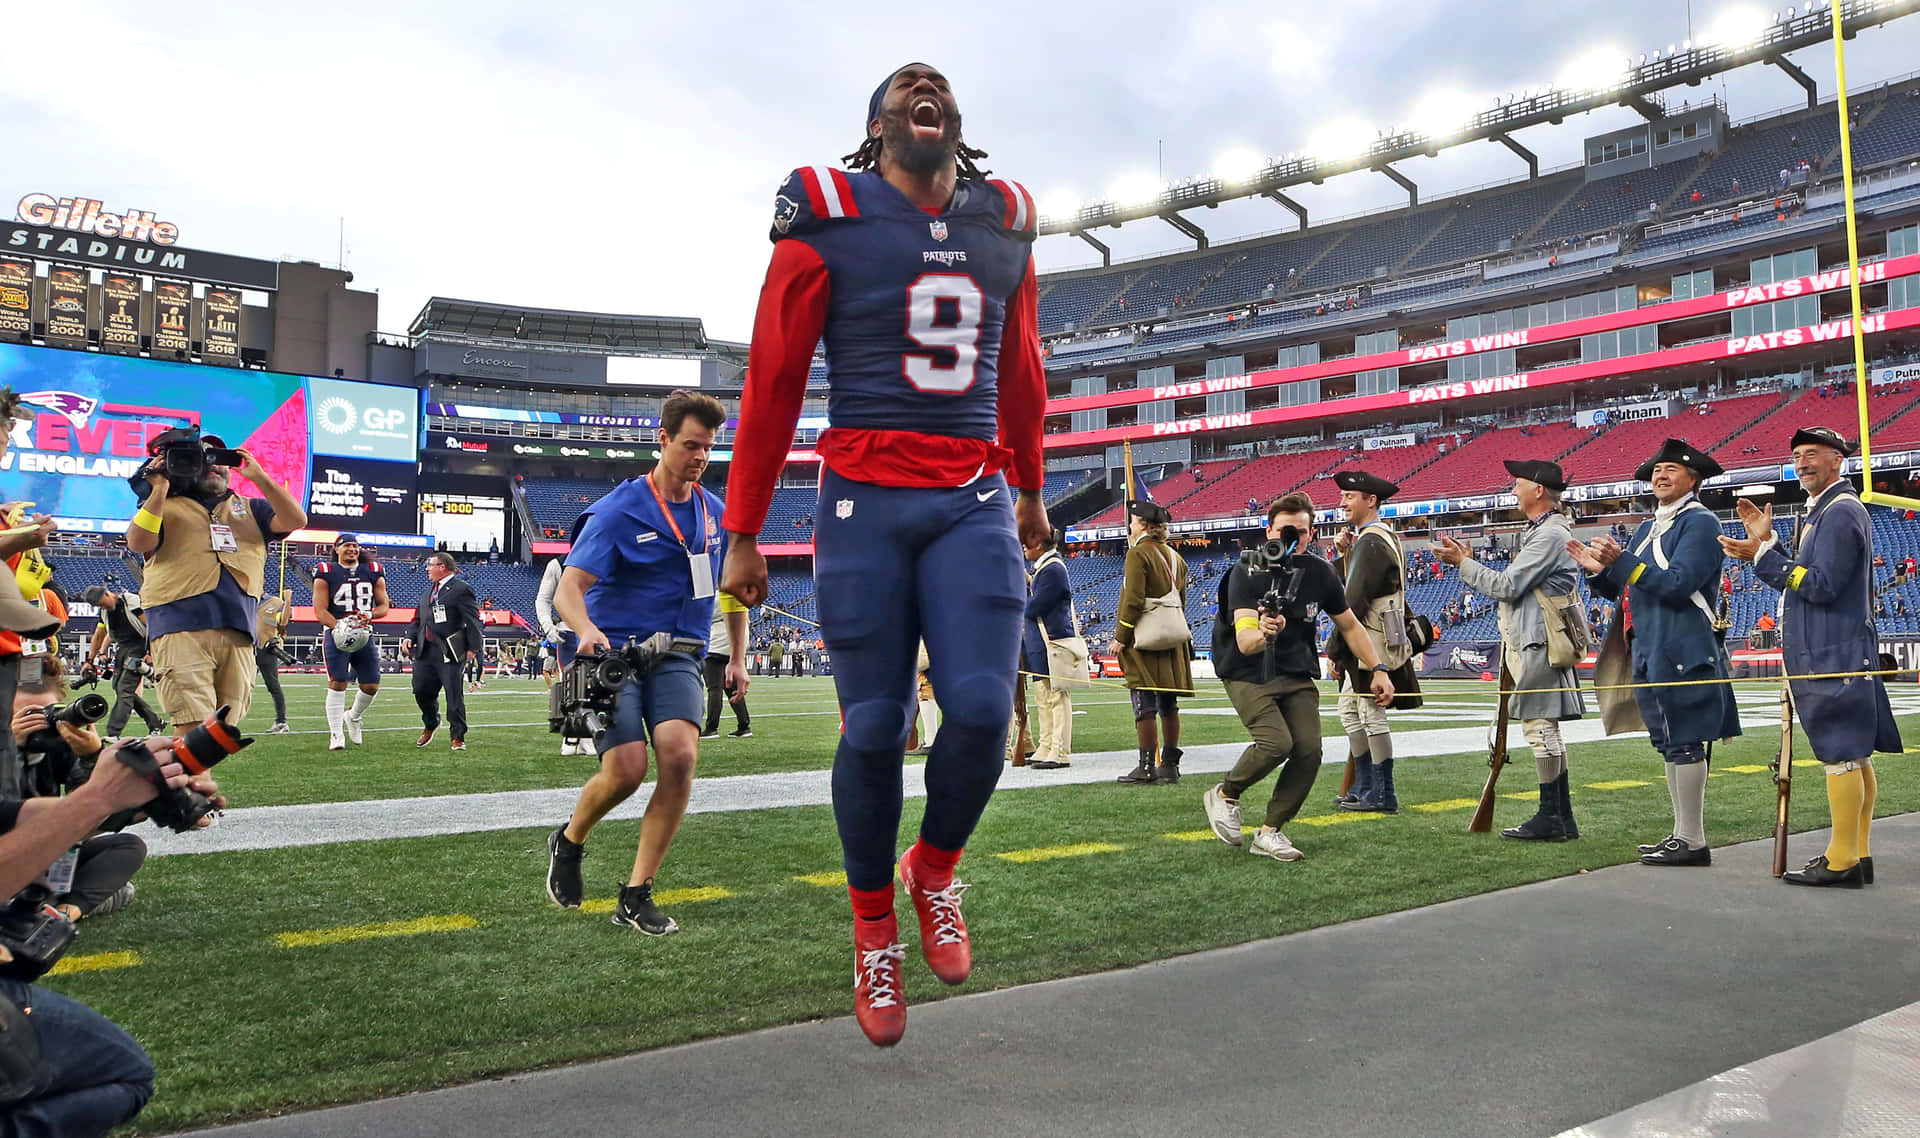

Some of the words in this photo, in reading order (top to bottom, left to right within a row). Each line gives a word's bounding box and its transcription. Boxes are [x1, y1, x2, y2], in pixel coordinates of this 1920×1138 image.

[17, 192, 179, 246] Gillette
[8, 229, 186, 270] STADIUM
[923, 251, 967, 262] PATRIOTS
[1726, 279, 1803, 307] PATS
[1808, 262, 1886, 291] WIN!
[50, 325, 84, 336] 2004
[105, 332, 136, 343] 2014
[903, 272, 985, 394] 9
[1727, 328, 1803, 355] PATS
[1809, 315, 1886, 343] WIN!
[157, 338, 187, 349] 2016
[207, 344, 235, 354] 2018
[1408, 341, 1466, 362] PATS
[1470, 330, 1528, 352] WIN!
[463, 350, 526, 369] Encore
[1153, 382, 1203, 399] PATS
[1206, 375, 1252, 392] WIN!
[1408, 384, 1467, 404] PATS
[1470, 374, 1528, 394] WIN!
[363, 407, 406, 430] GP
[580, 415, 632, 426] WELCOME
[638, 418, 651, 426] TO
[1153, 420, 1203, 436] PATS
[1206, 413, 1252, 430] WIN!
[462, 441, 488, 450] Mutual
[1380, 438, 1408, 448] Putnam
[325, 469, 351, 484] The
[1709, 474, 1731, 485] RUSH
[312, 481, 364, 495] network
[1573, 486, 1588, 500] 45
[1614, 484, 1634, 496] 4TH
[311, 491, 364, 507] America
[1500, 495, 1518, 507] 2ND
[311, 504, 346, 516] relies
[347, 506, 364, 517] on
[421, 502, 435, 512] 25
[444, 502, 473, 513] 30:00
[1396, 500, 1415, 516] IND
[1427, 501, 1435, 513] 3
[1314, 511, 1326, 523] 26
[376, 534, 428, 547] EMPOWER
[334, 581, 374, 613] 48
[68, 602, 100, 617] 2ND
